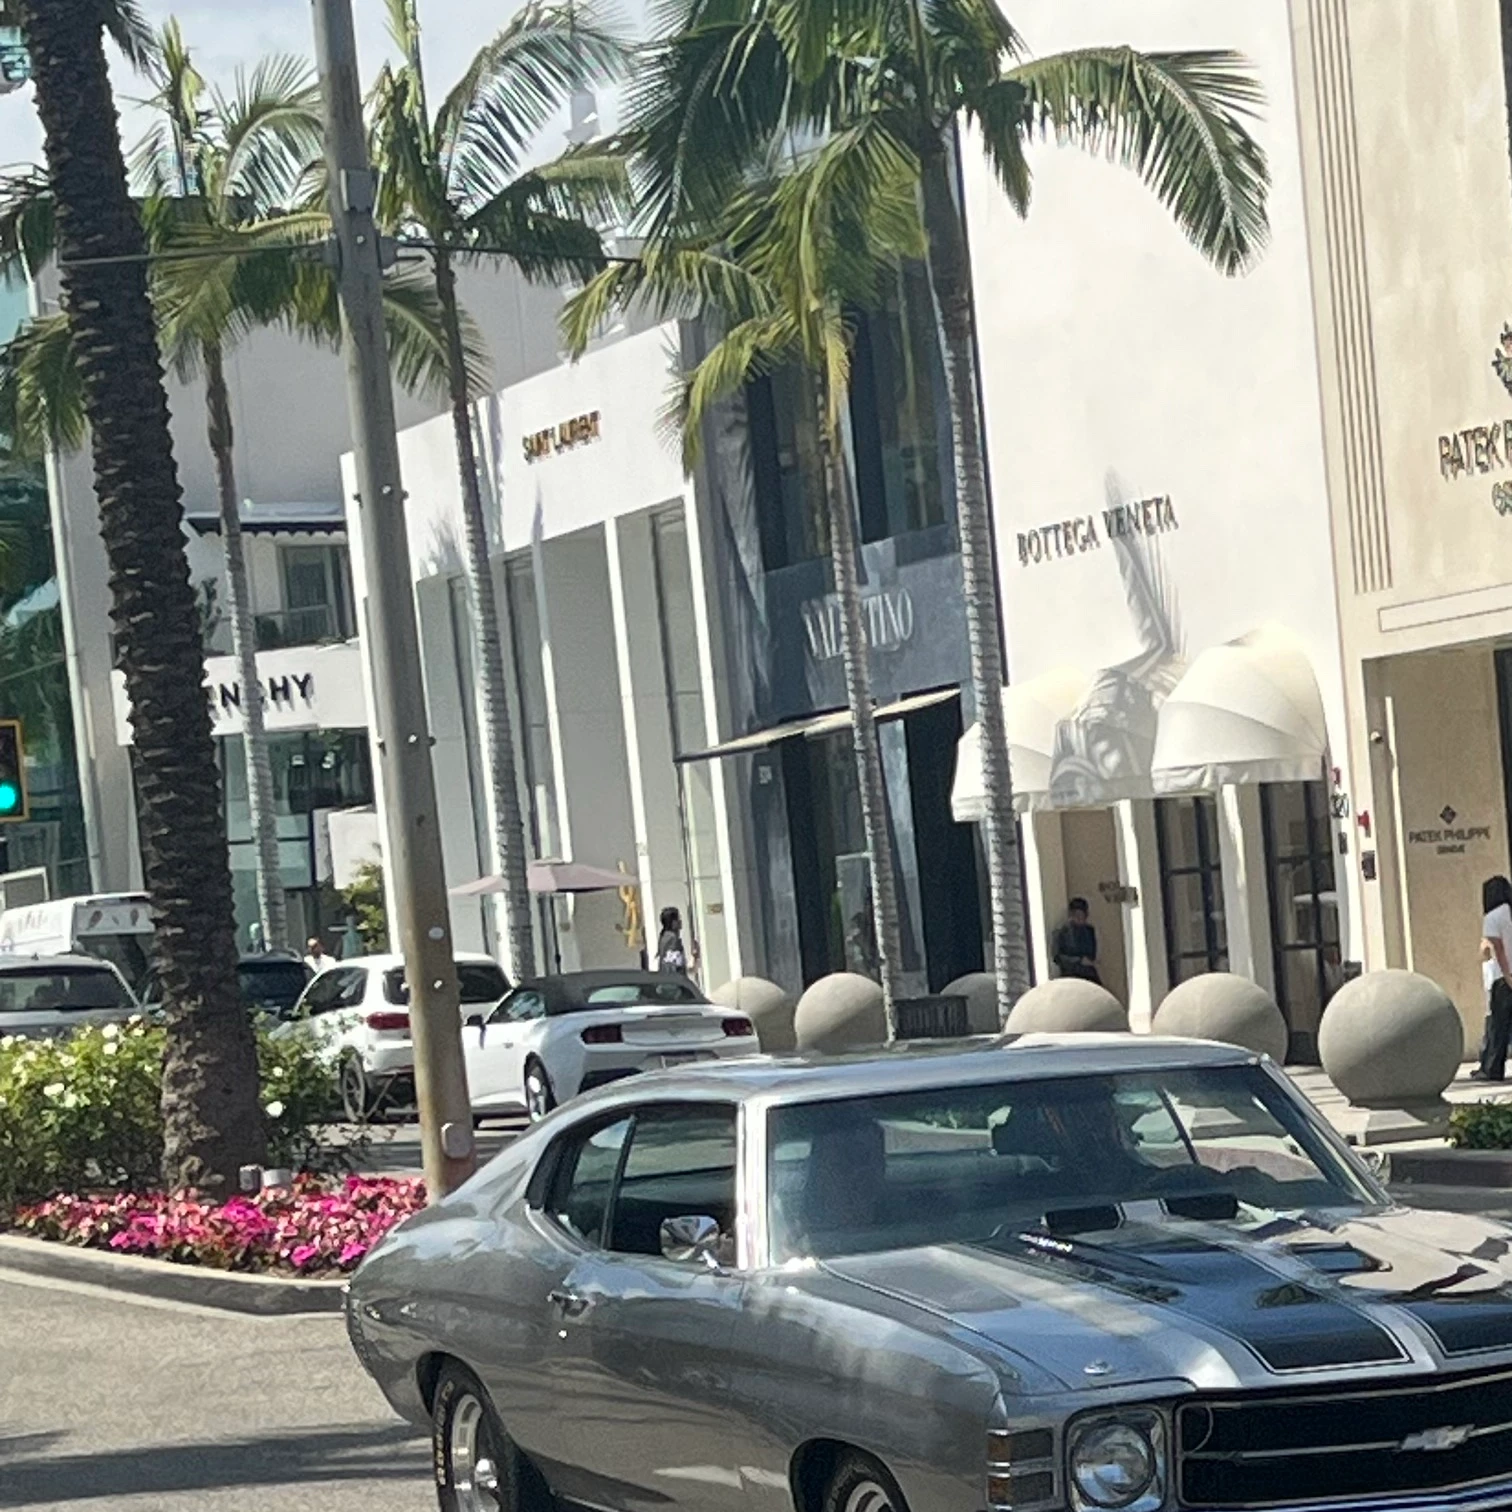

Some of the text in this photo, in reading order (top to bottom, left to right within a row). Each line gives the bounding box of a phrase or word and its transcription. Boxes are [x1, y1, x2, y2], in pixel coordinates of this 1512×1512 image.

[1438, 422, 1504, 482] PATEK
[1016, 493, 1179, 567] BOTTEGA VENETA
